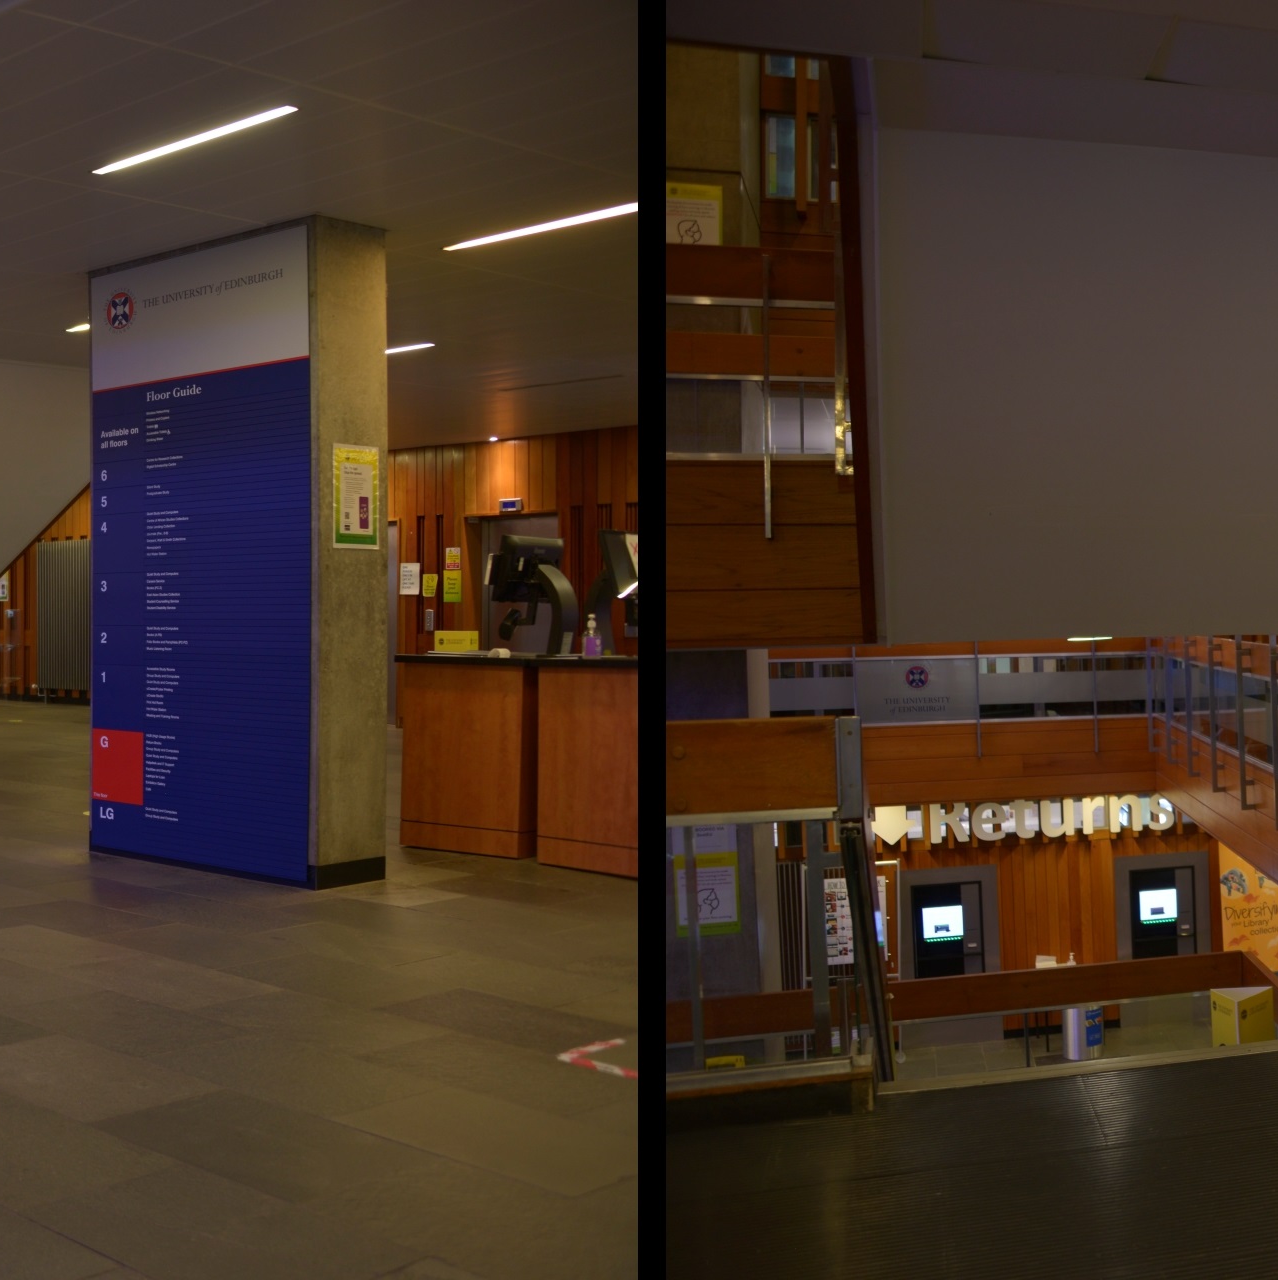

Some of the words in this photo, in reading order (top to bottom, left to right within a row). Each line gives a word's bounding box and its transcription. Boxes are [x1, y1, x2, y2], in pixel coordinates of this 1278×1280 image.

[143, 297, 160, 308] THE
[162, 285, 214, 304] UNIVERSITY
[215, 281, 224, 296] of
[224, 268, 284, 290] EDINBURGH
[146, 391, 170, 402] Floor
[172, 384, 202, 398] Guide
[100, 428, 129, 438] Available
[110, 439, 128, 448] floors
[100, 470, 108, 481] 6
[100, 496, 108, 507] 5
[100, 522, 108, 533] 4
[100, 580, 108, 592] 3
[100, 632, 108, 644] 2
[101, 671, 106, 683] 1
[100, 735, 109, 748] G
[100, 806, 114, 820] LG
[929, 793, 1175, 844] Returns
[1243, 919, 1269, 928] Library
